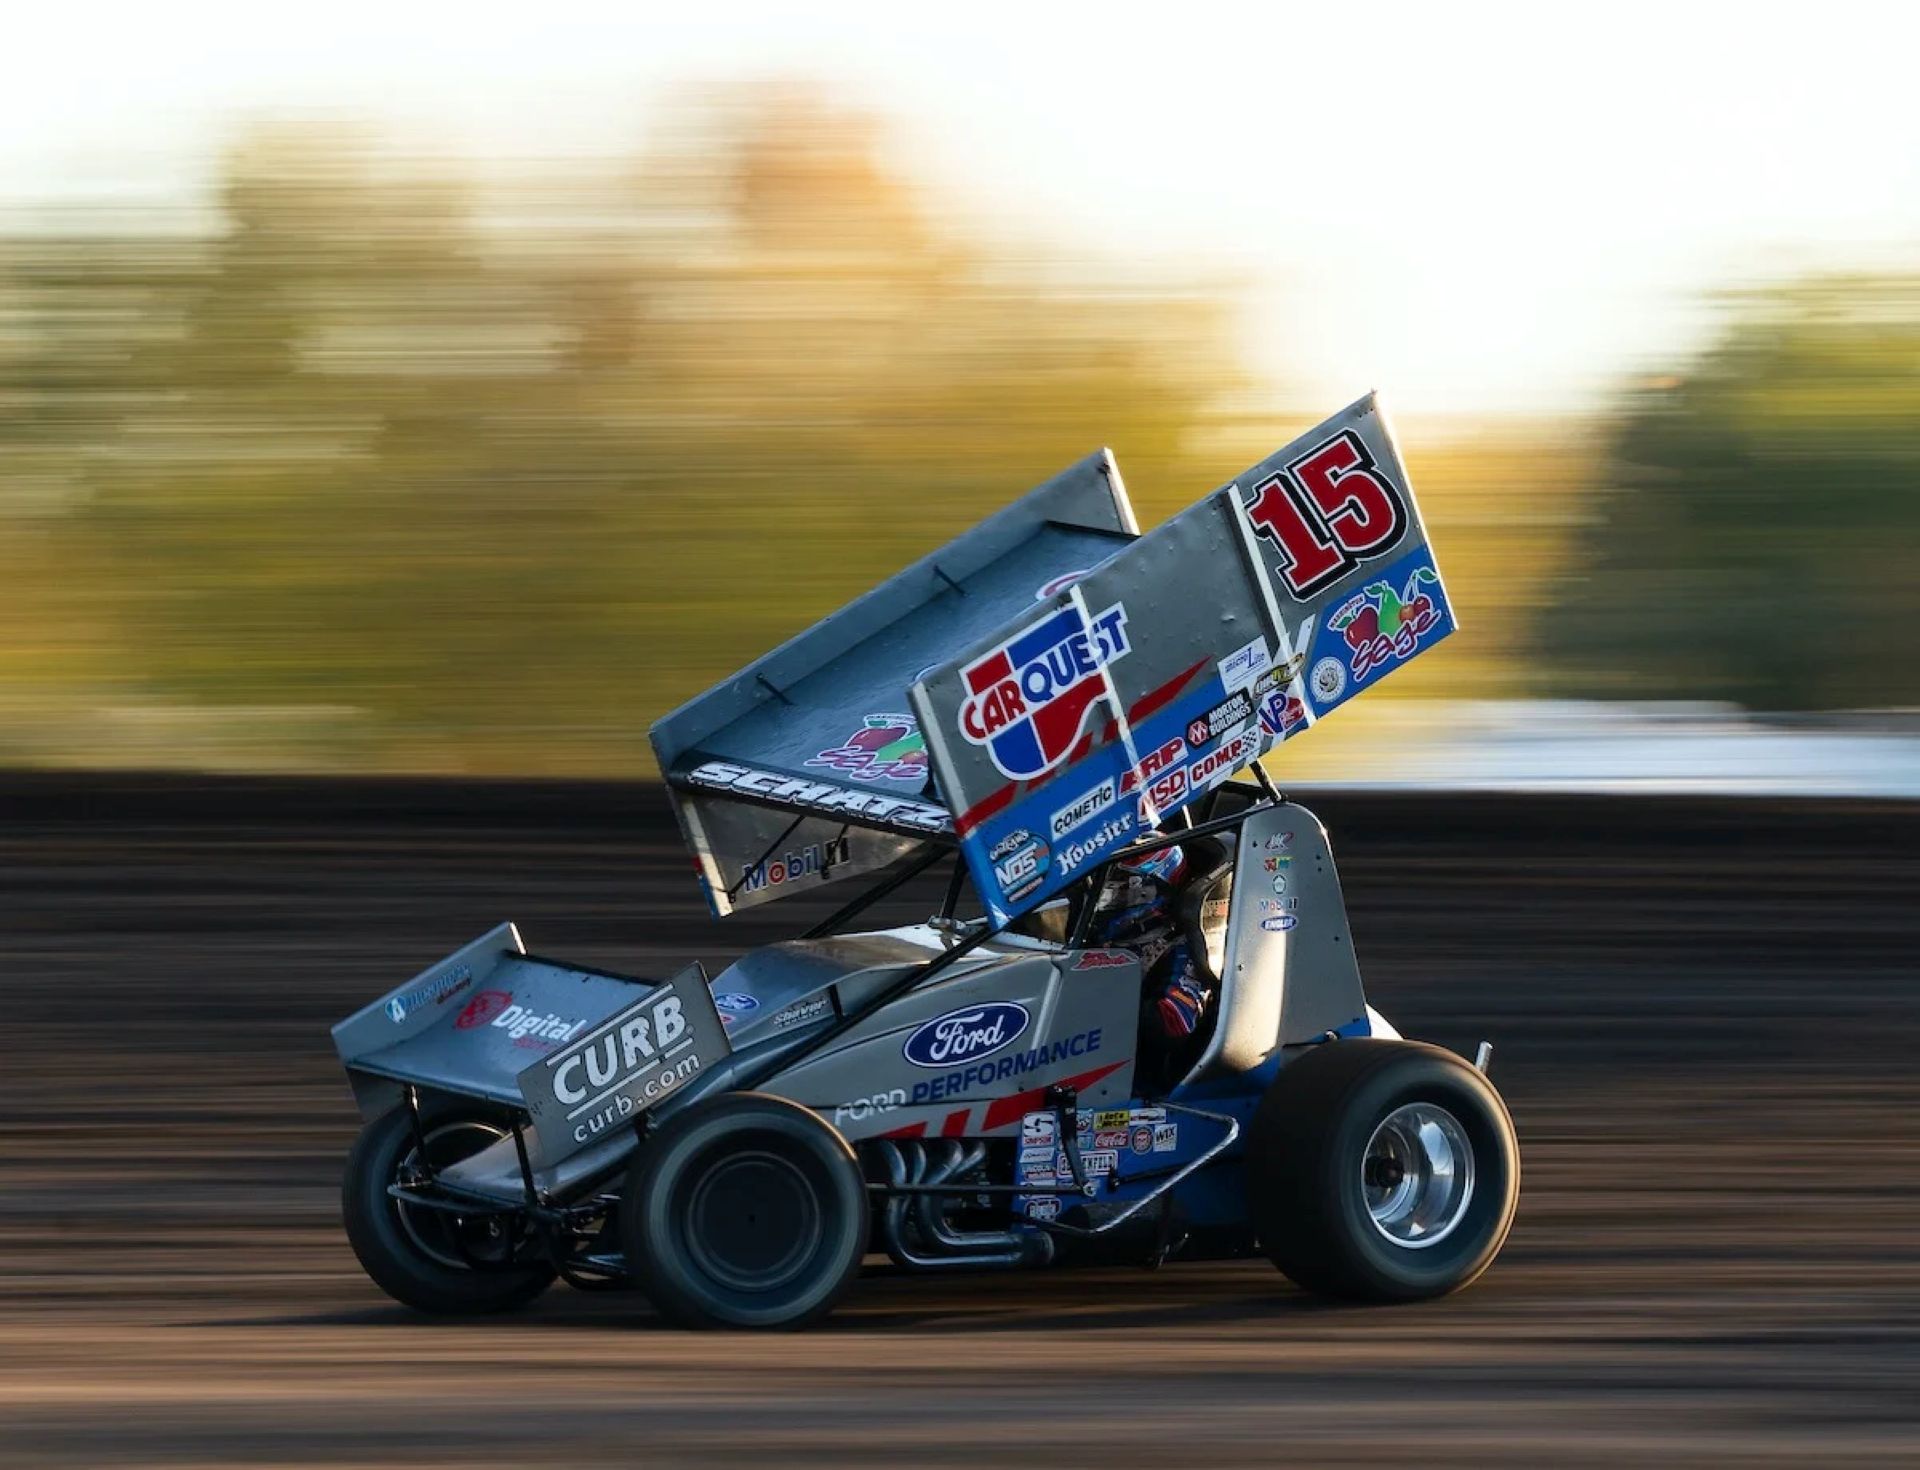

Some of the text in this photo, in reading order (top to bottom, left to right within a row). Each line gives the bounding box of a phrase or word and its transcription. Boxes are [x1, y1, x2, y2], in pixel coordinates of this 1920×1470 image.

[1245, 430, 1408, 602] 15
[1208, 694, 1245, 721] MORTON
[1208, 701, 1252, 737] BUILDINGS
[1259, 693, 1287, 734] VP
[1120, 738, 1185, 795] ARP
[687, 760, 952, 834] SCHATZ
[742, 844, 820, 895] Mobil
[995, 842, 1037, 888] NOS
[1056, 813, 1134, 876] Hoosier
[490, 1004, 587, 1043] Digital
[930, 1013, 1005, 1062] Ford
[552, 996, 688, 1106] CURB
[834, 1028, 1103, 1126] FORD PERFORMANCE
[573, 1052, 700, 1144] curb.com
